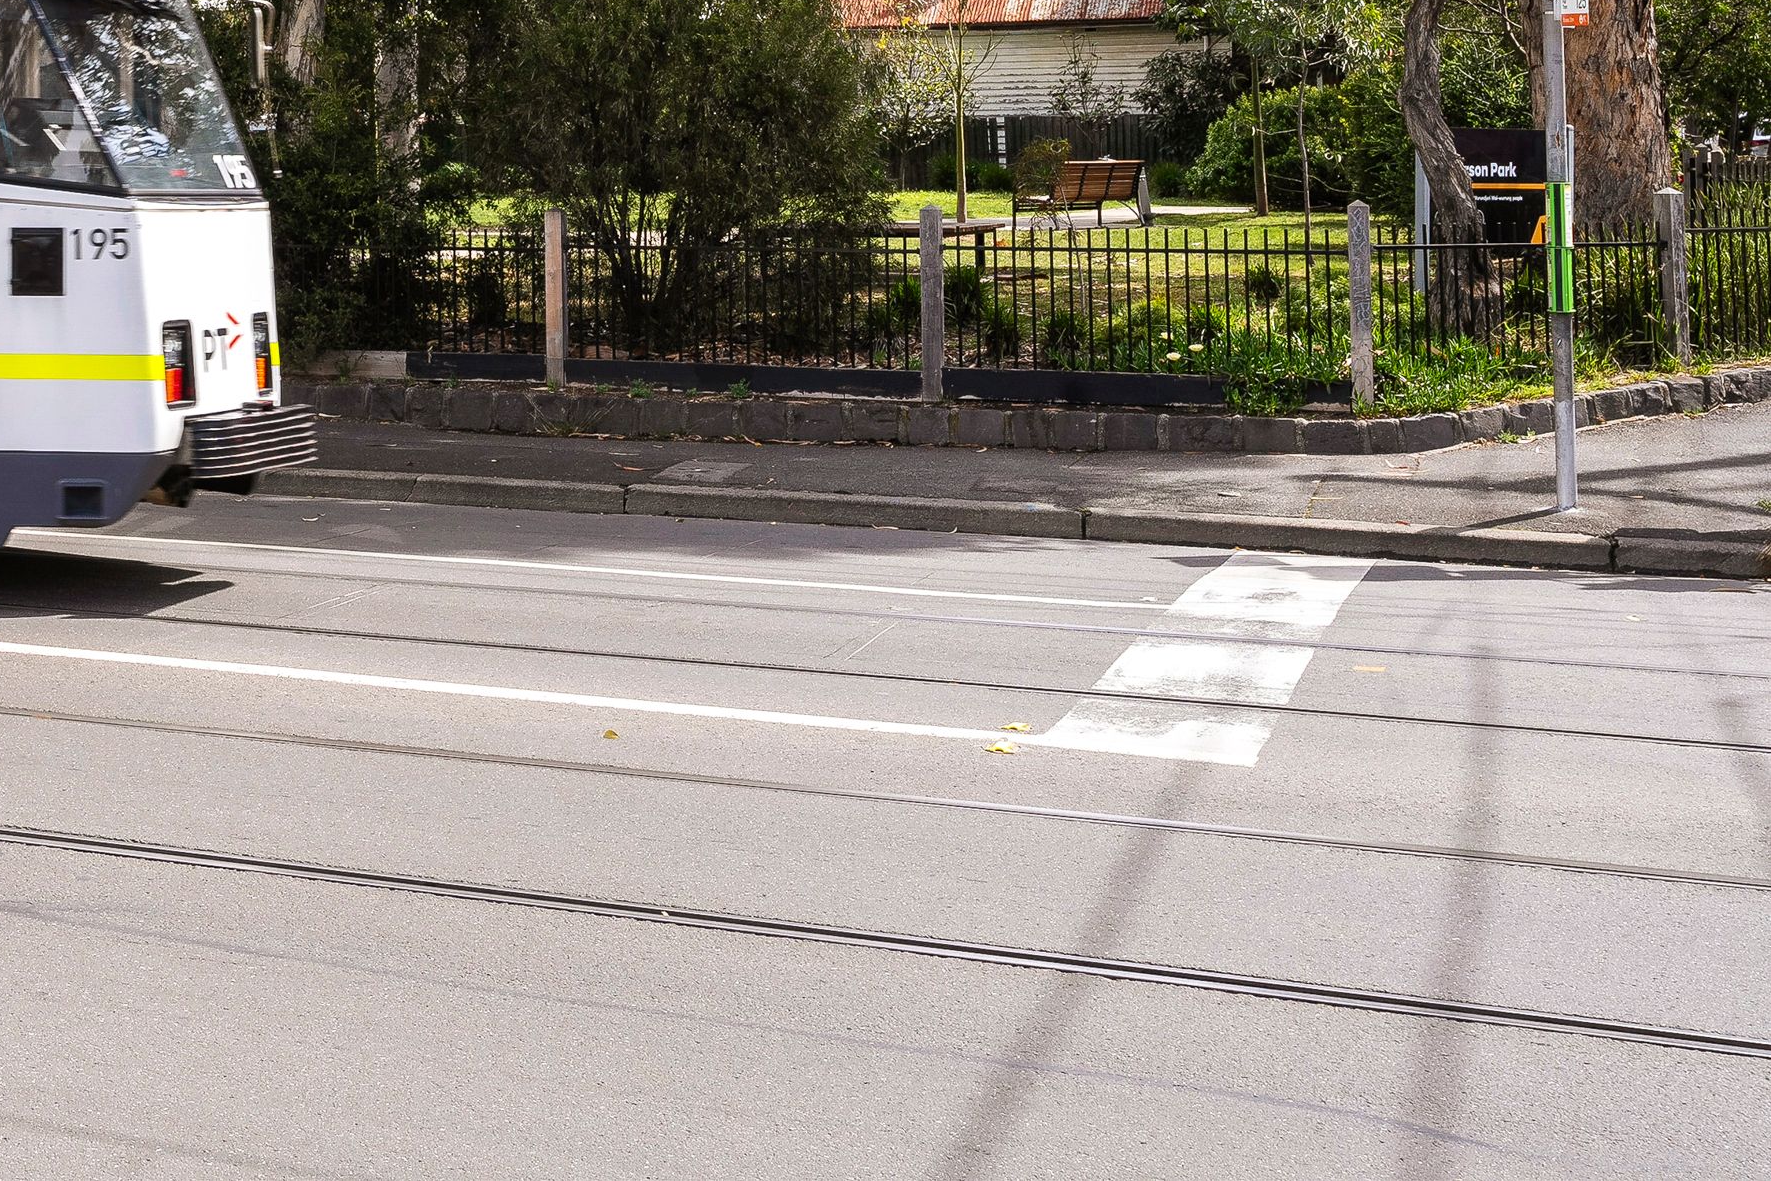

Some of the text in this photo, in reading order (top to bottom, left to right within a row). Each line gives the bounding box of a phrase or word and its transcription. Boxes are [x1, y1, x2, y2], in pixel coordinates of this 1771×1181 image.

[212, 155, 256, 189] 195
[1490, 162, 1517, 177] Park
[69, 228, 130, 260] 195
[202, 328, 228, 372] PT
